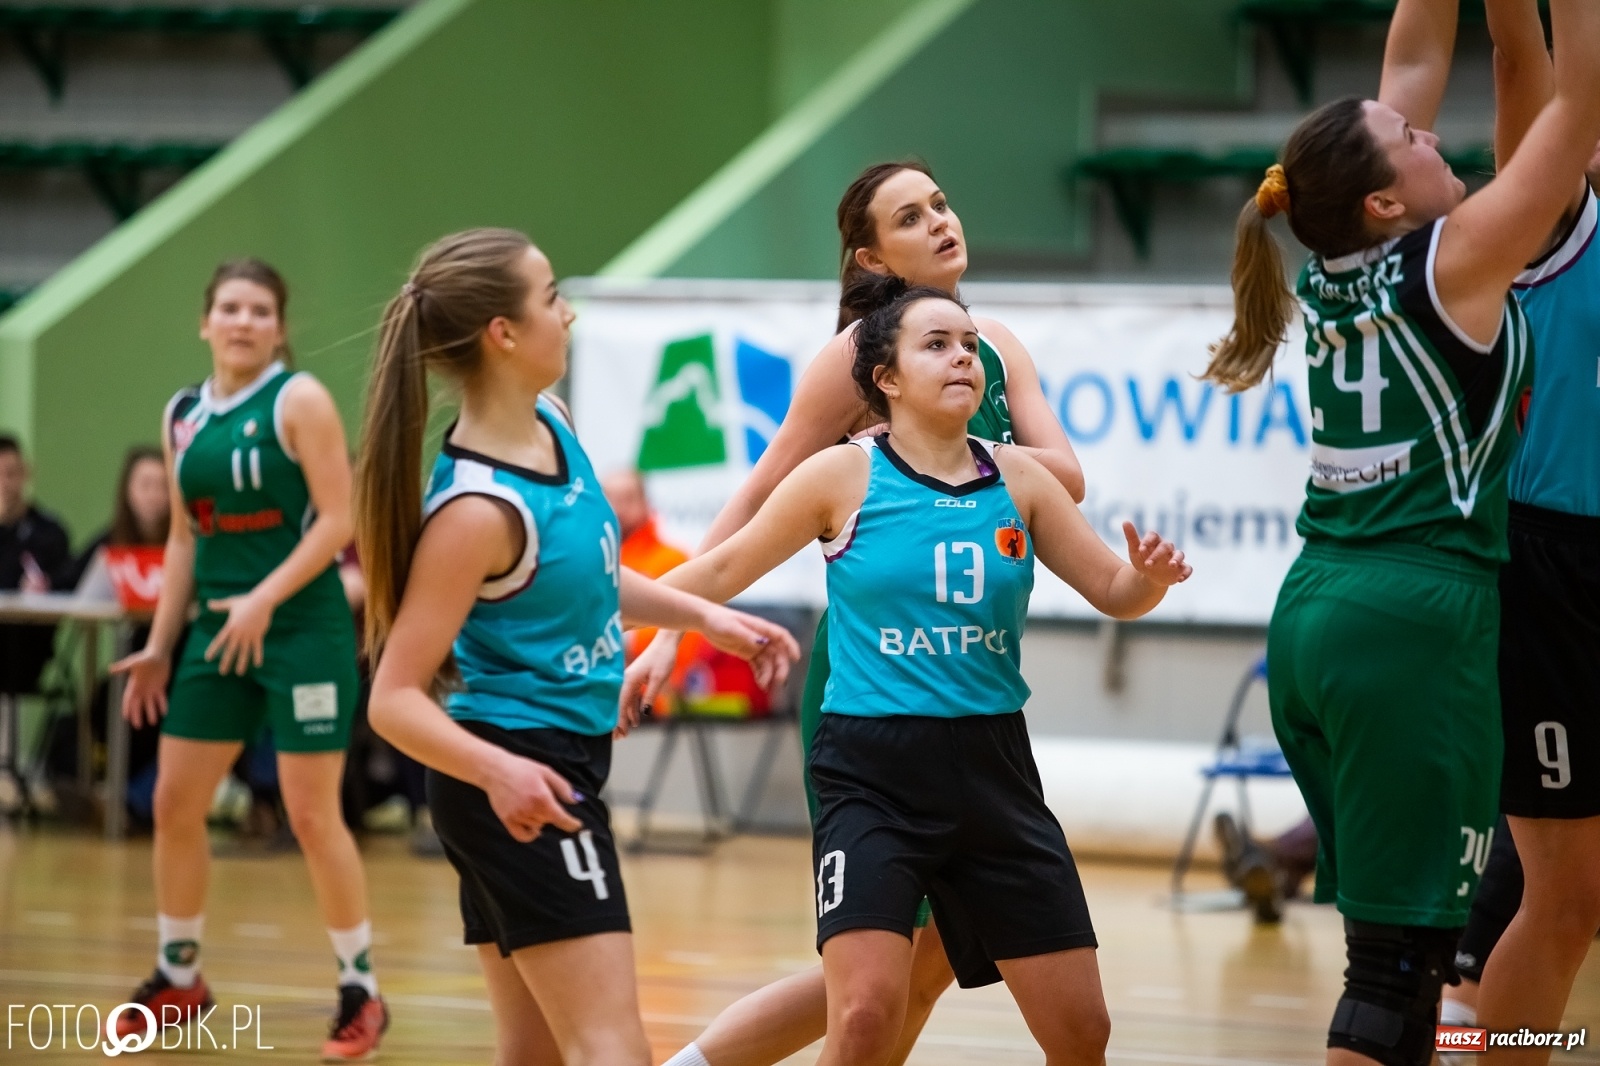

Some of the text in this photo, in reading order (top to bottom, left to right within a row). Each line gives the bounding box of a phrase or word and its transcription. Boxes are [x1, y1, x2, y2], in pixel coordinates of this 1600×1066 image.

[1040, 374, 1308, 445] OWIA
[232, 447, 262, 492] 11
[934, 498, 977, 508] COLO
[600, 520, 619, 588] 4
[934, 541, 985, 605] 13
[1534, 721, 1572, 789] 9
[560, 830, 609, 900] 4
[817, 849, 846, 919] 13
